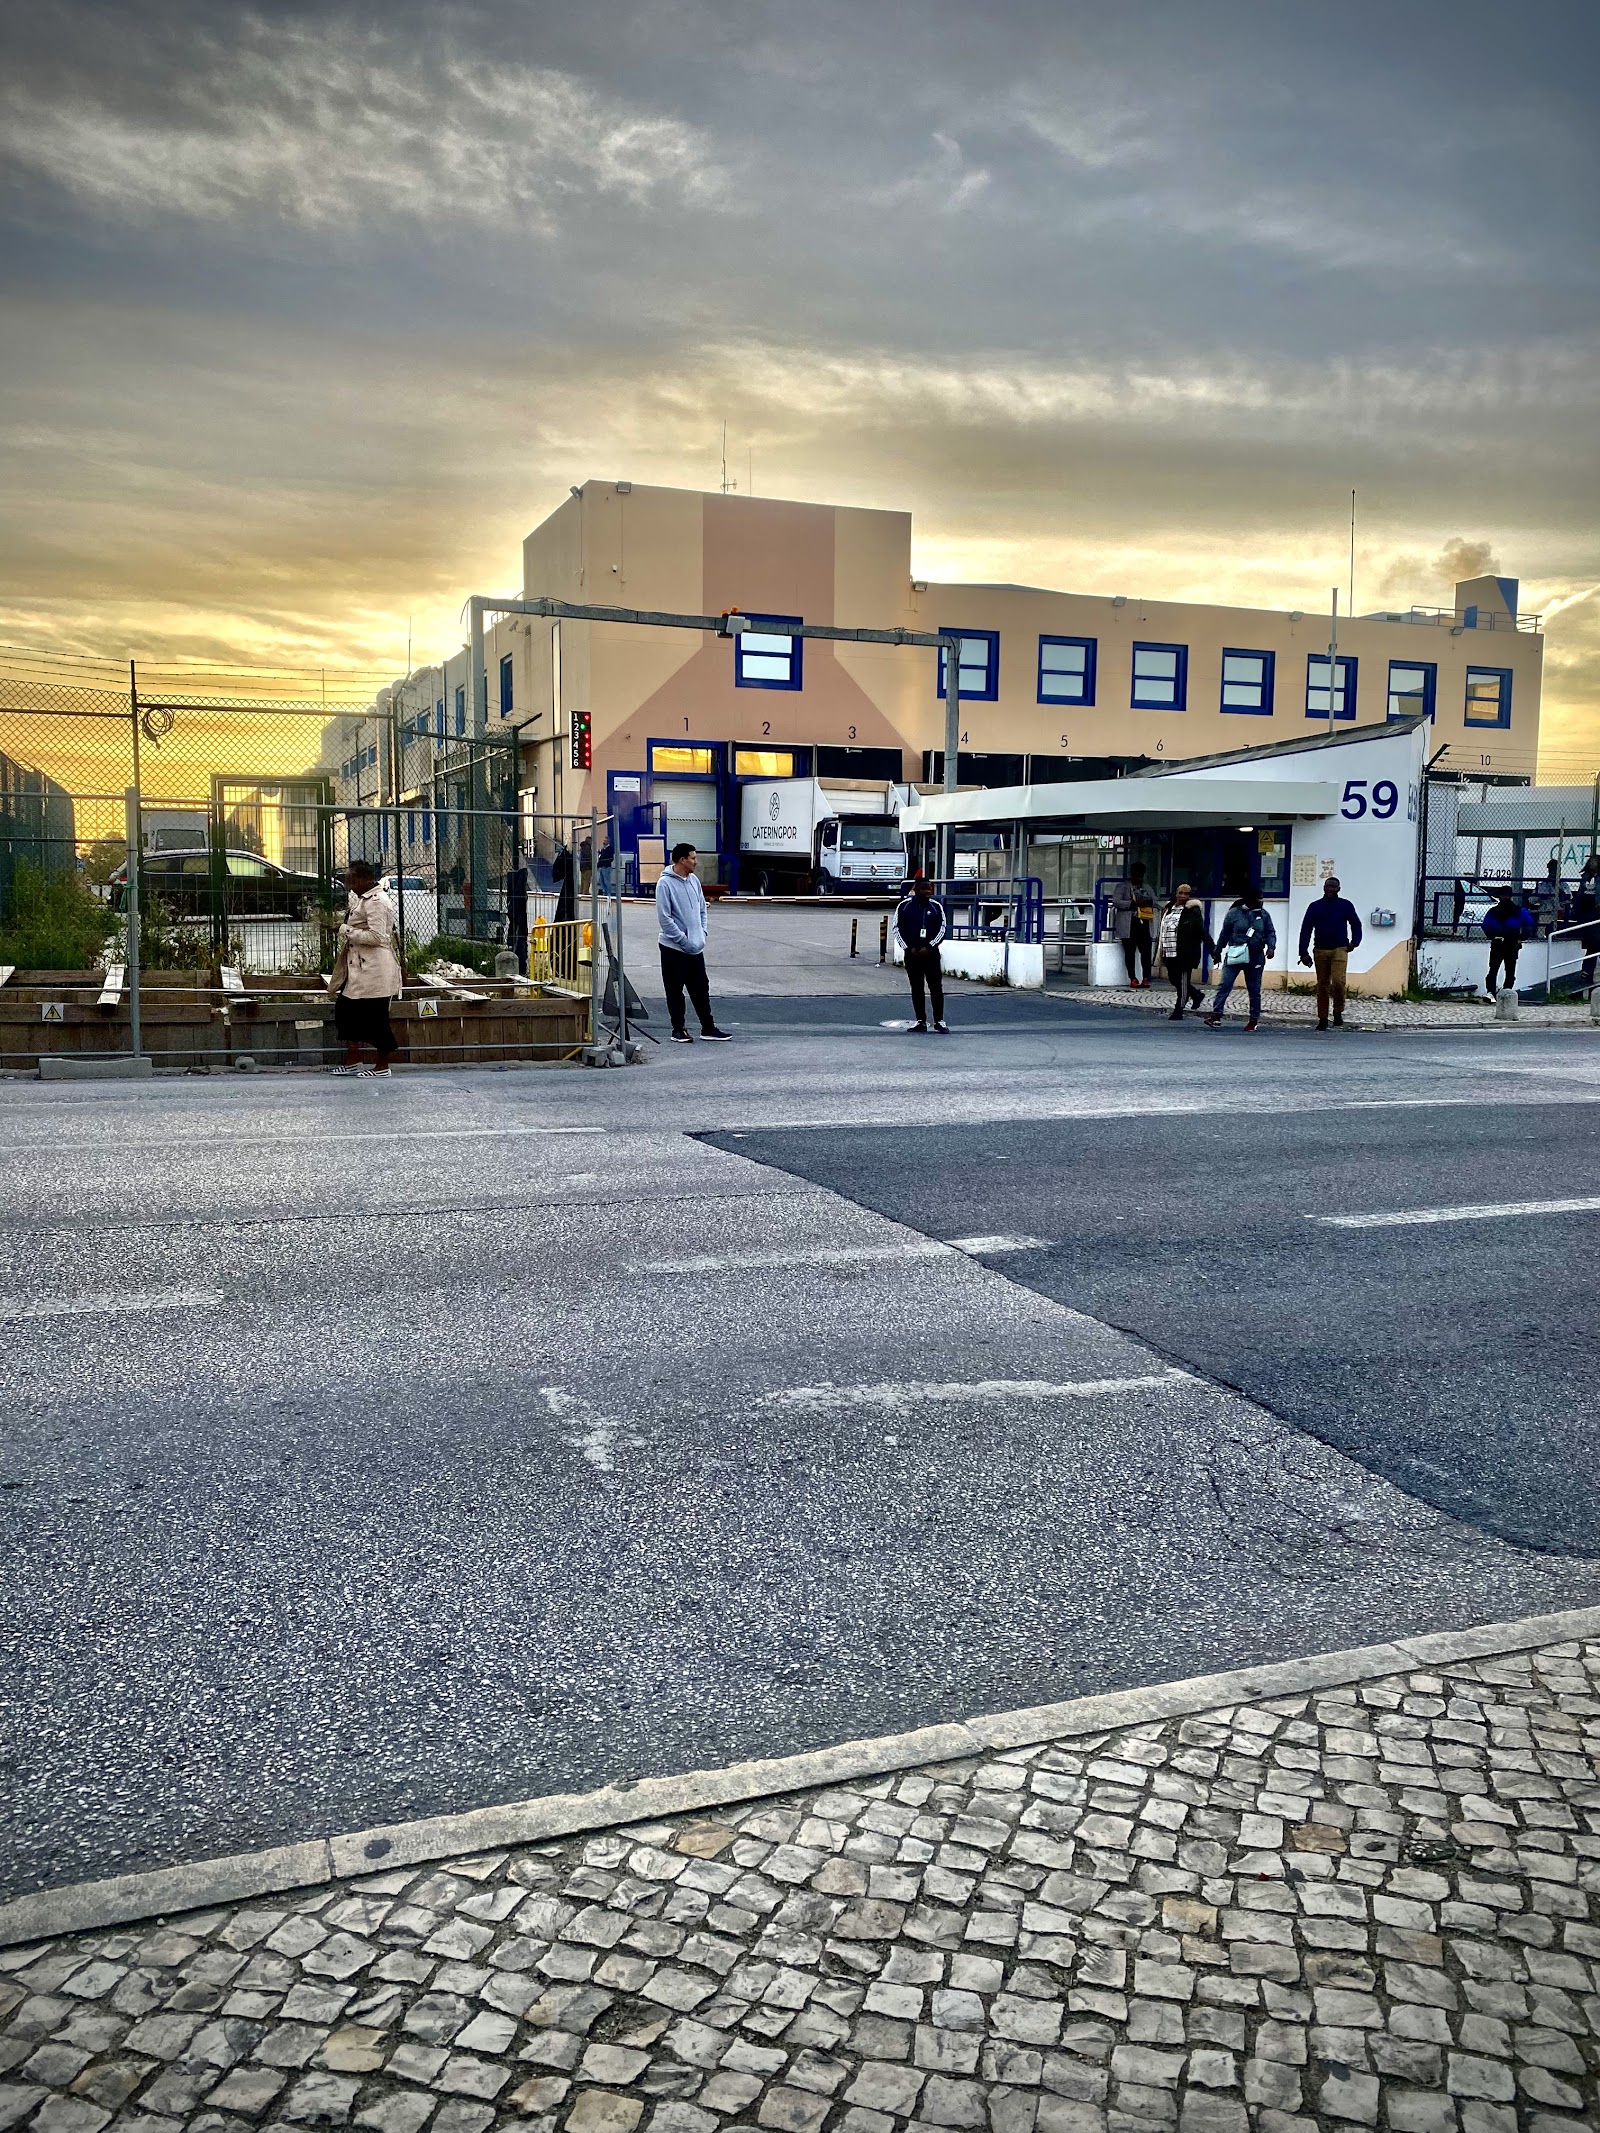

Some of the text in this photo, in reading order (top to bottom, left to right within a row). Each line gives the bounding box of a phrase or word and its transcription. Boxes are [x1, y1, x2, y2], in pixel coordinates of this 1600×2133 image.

[573, 713, 579, 721] 1
[573, 723, 580, 731] 2
[684, 717, 689, 732] 1
[762, 721, 771, 736] 2
[573, 731, 580, 739] 3
[848, 725, 857, 740] 3
[960, 731, 969, 744] 4
[573, 741, 579, 749] 4
[1060, 734, 1068, 748] 5
[1156, 739, 1164, 752] 6
[573, 750, 579, 758] 5
[1480, 754, 1491, 766] 10
[573, 759, 579, 767] 6
[1340, 780, 1399, 820] 59
[752, 826, 797, 840] CATERINGPOR
